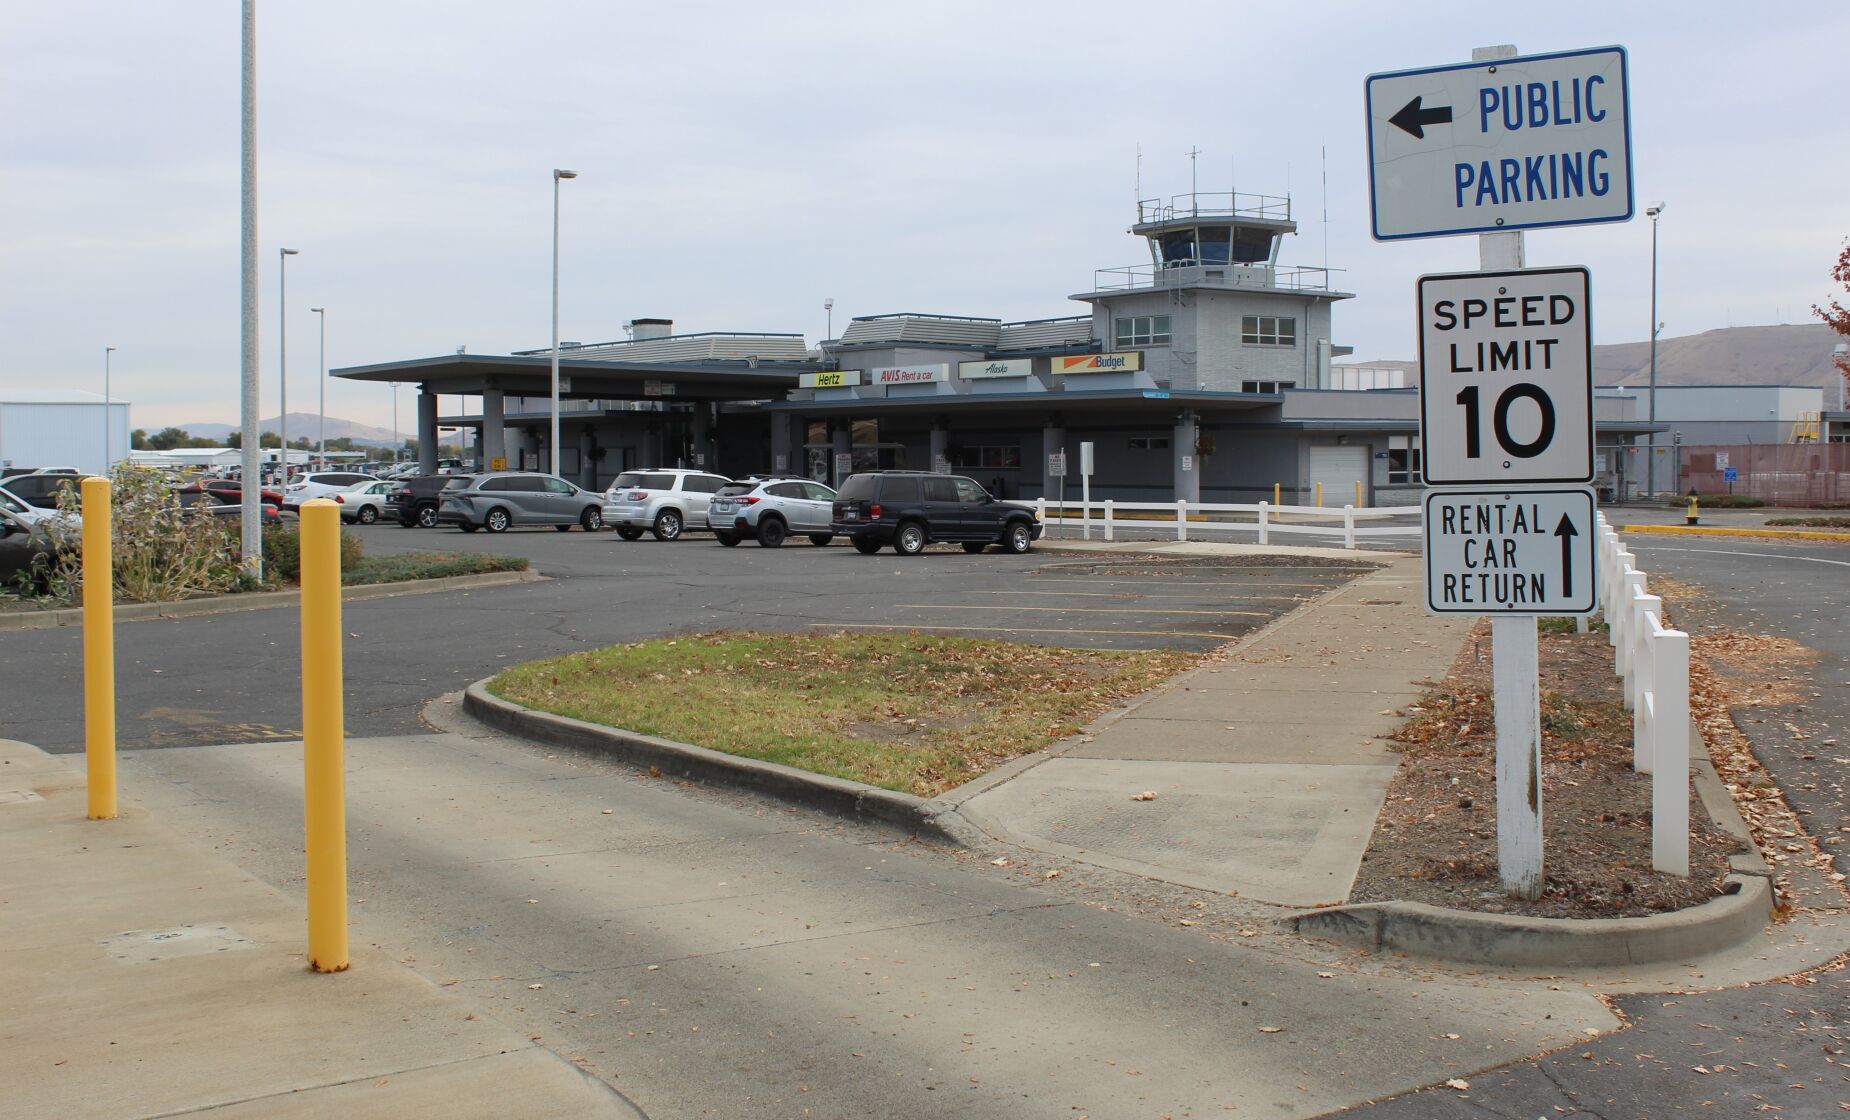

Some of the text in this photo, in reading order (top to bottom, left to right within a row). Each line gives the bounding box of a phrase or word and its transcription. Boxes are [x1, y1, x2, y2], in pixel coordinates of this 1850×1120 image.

[1479, 74, 1606, 133] PUBLIC
[1455, 148, 1609, 208] PARKING
[1434, 294, 1575, 331] SPEED
[1096, 355, 1125, 370] Budget
[1450, 339, 1558, 373] LIMIT
[818, 373, 840, 385] Hertz
[881, 369, 901, 382] AVIS
[901, 371, 916, 381] Rent
[922, 370, 934, 379] car
[1456, 383, 1556, 459] 10
[1442, 504, 1545, 535] RENTAL
[1464, 539, 1517, 568] CAR
[1444, 573, 1545, 603] RETURN
